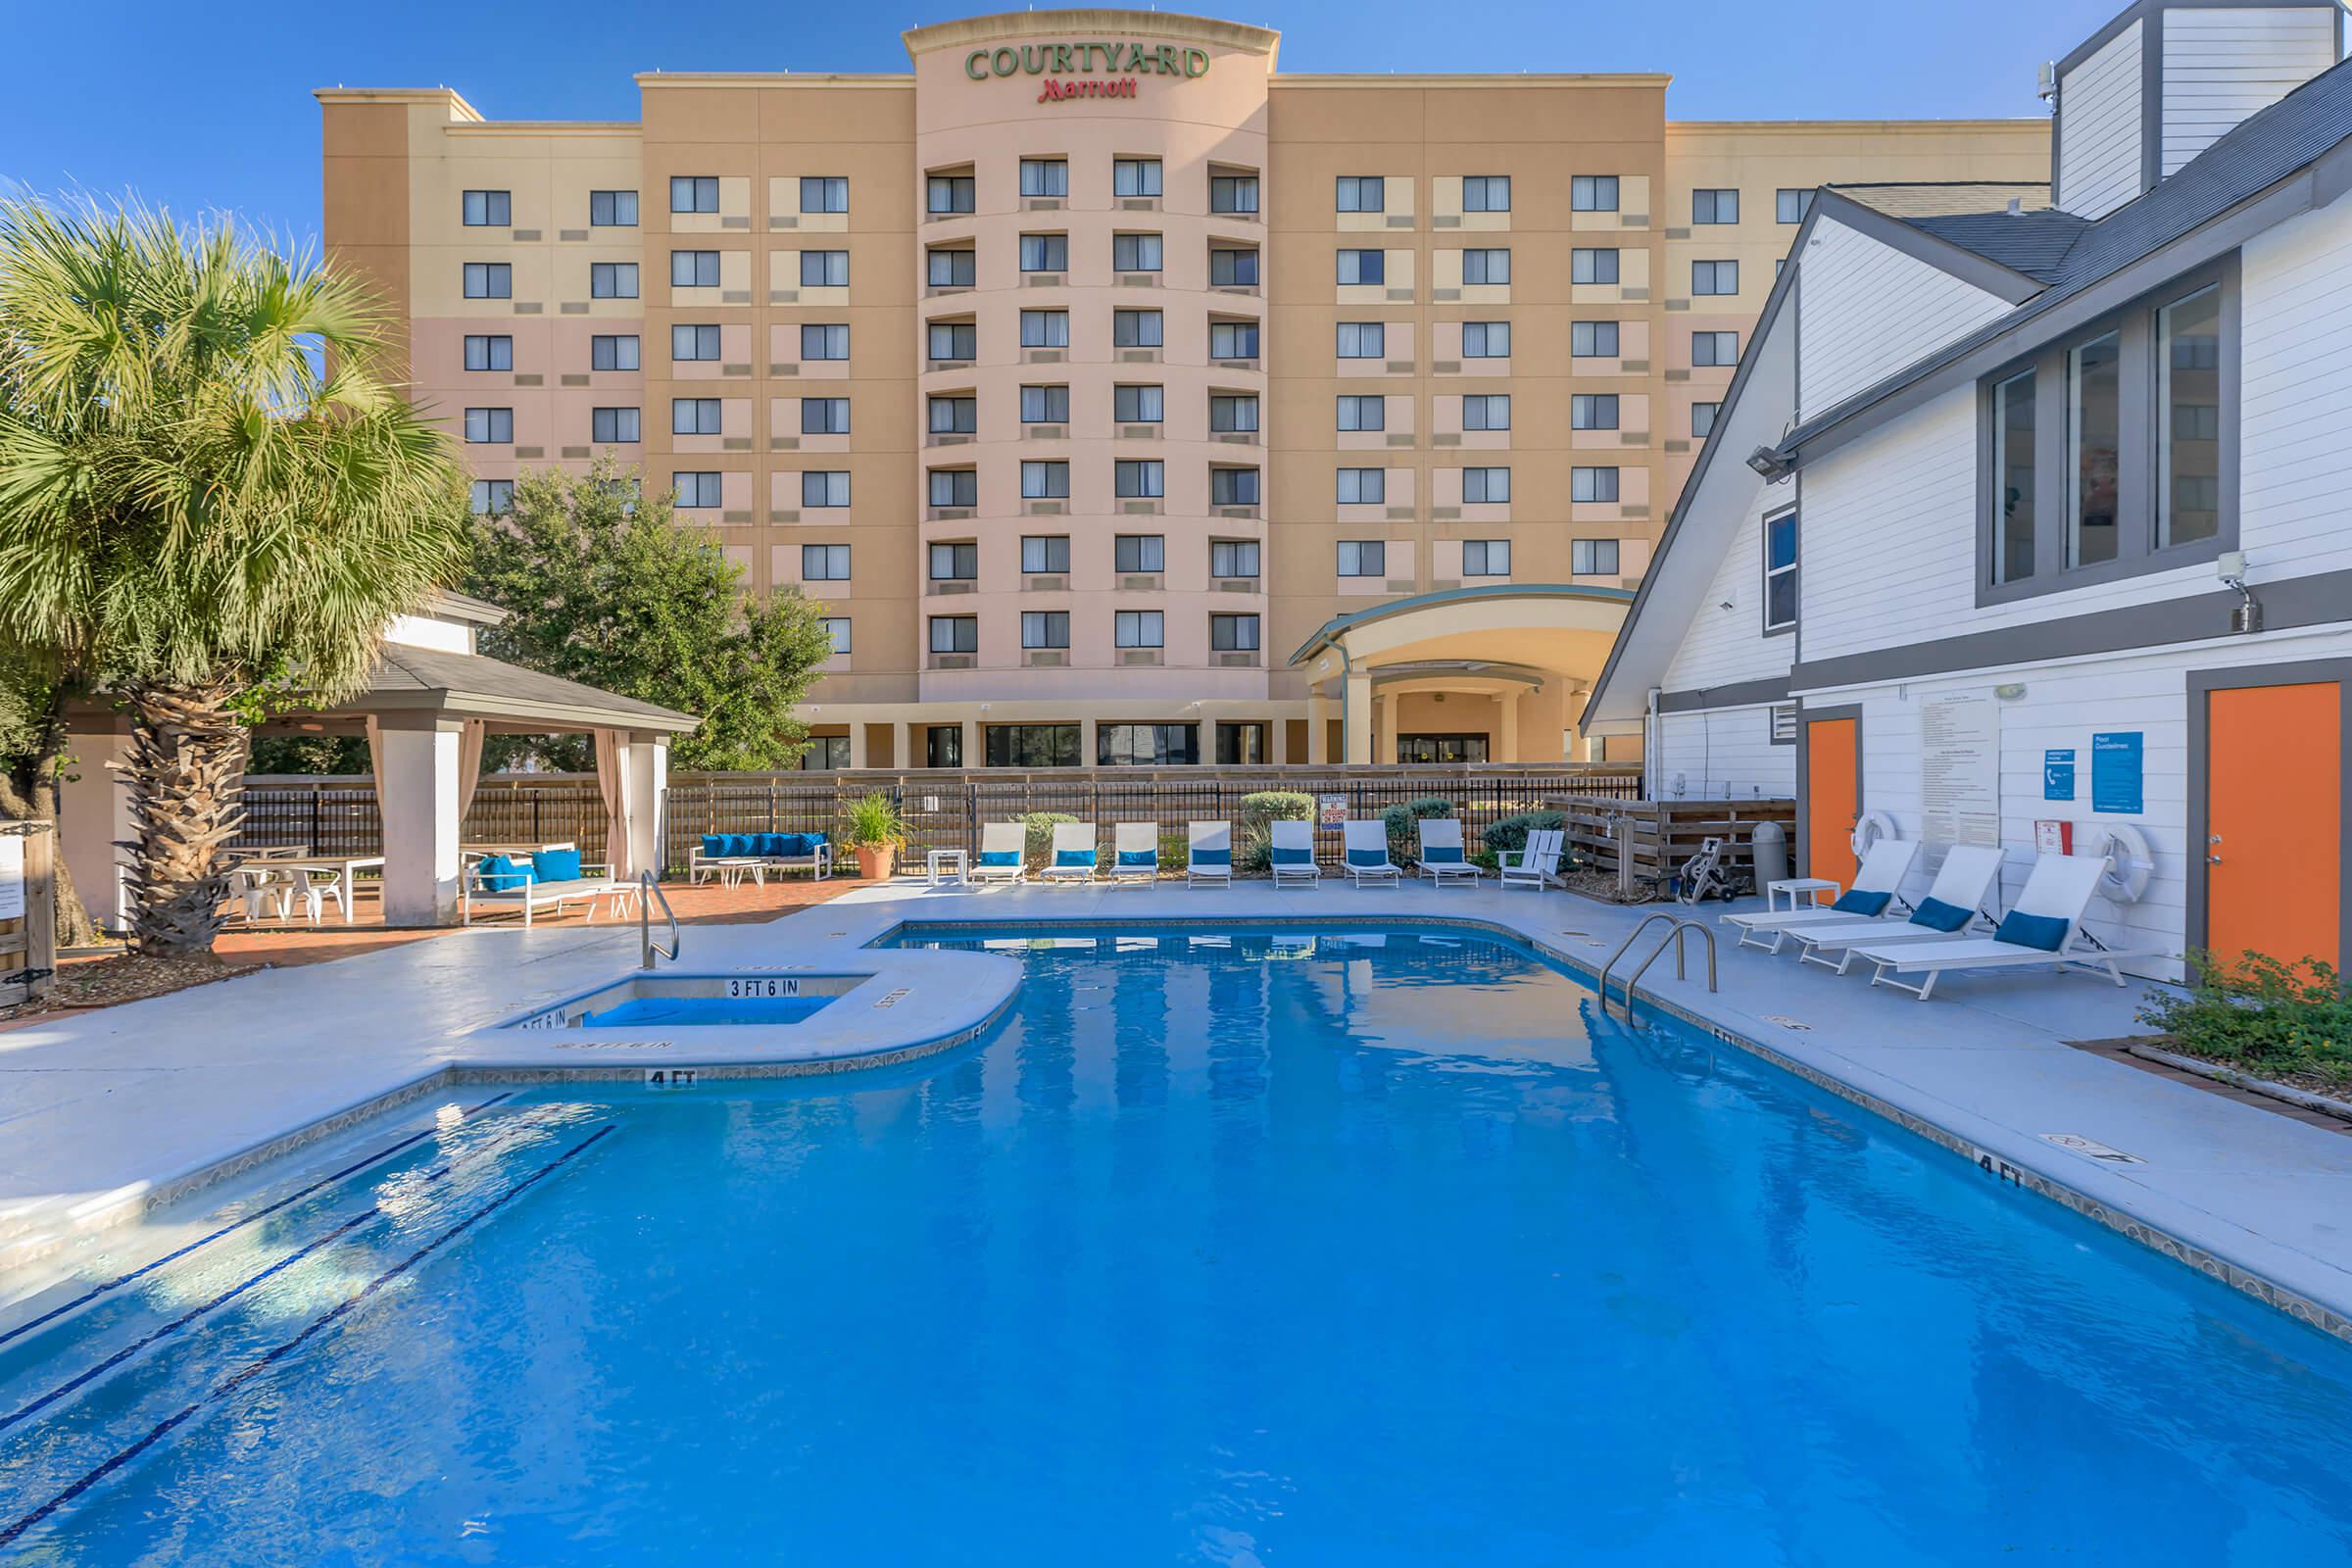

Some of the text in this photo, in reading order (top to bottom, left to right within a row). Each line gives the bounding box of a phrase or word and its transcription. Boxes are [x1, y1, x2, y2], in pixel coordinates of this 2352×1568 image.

[965, 42, 1209, 79] COURTYARD
[1037, 77, 1137, 103] Marriott
[731, 980, 798, 996] 3 FT 6 IN
[556, 1009, 565, 1027] IN
[650, 1070, 696, 1084] 4 FT
[1980, 1154, 2023, 1188] 4 FT
